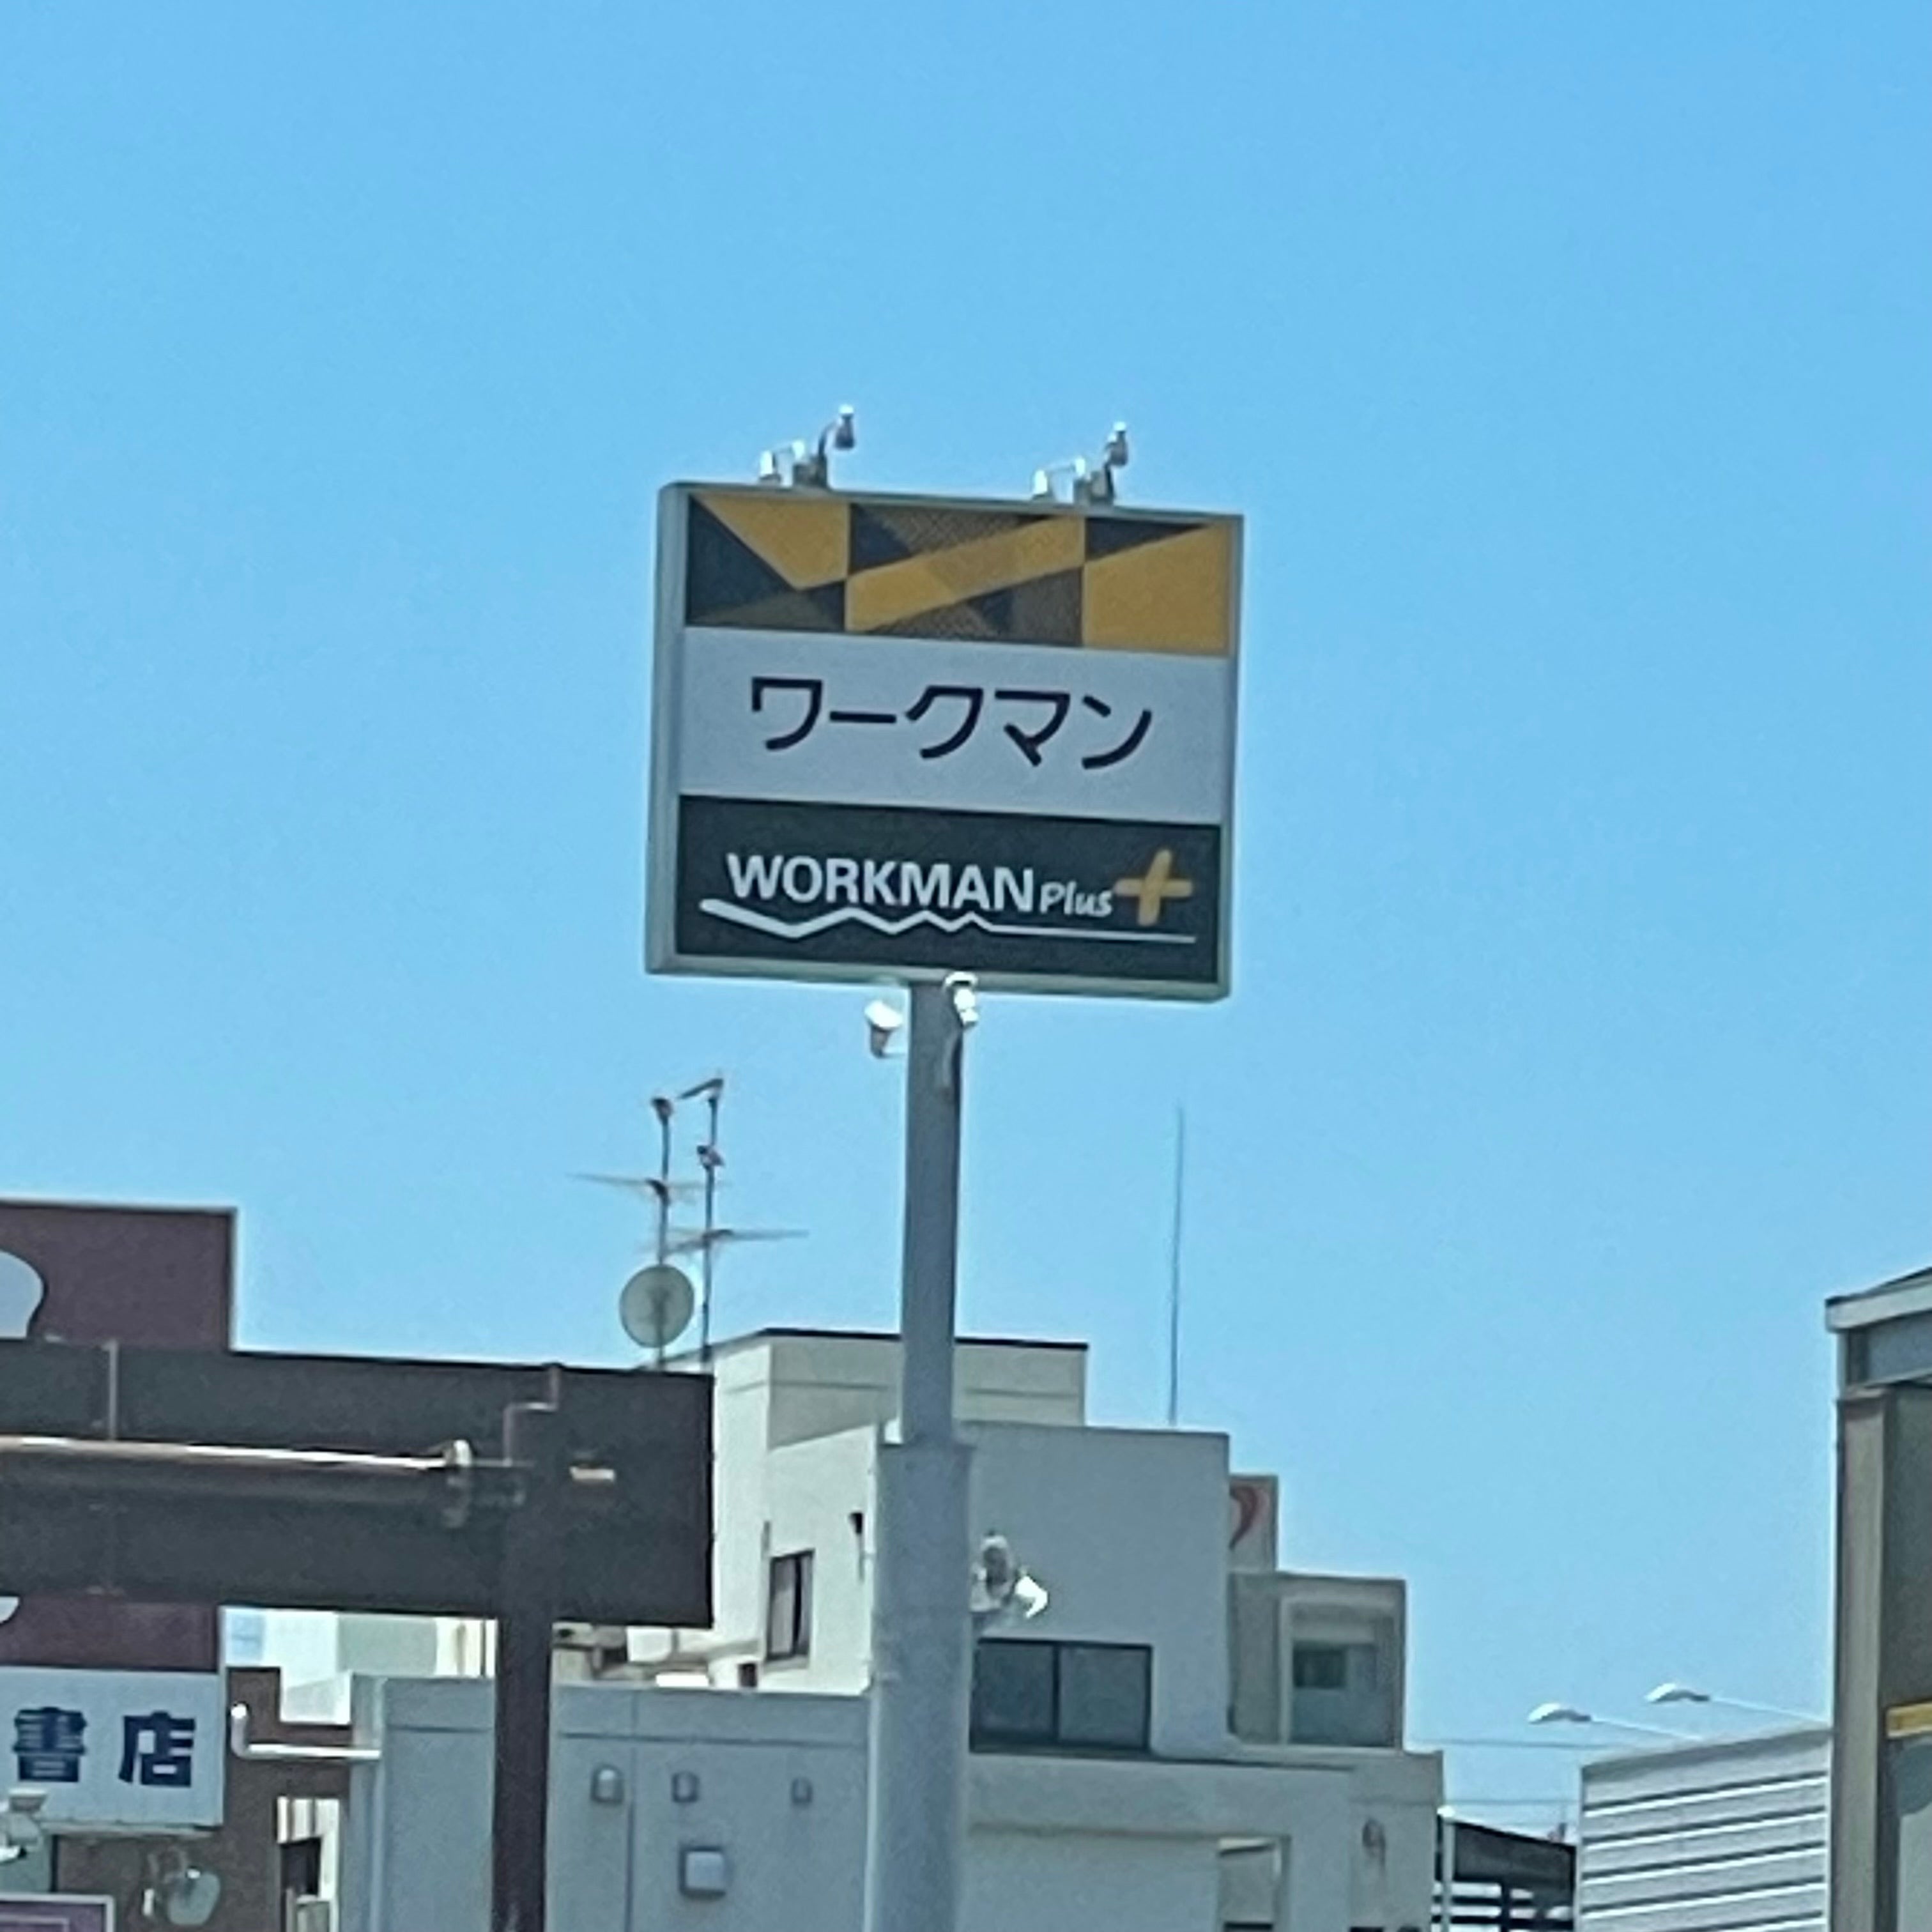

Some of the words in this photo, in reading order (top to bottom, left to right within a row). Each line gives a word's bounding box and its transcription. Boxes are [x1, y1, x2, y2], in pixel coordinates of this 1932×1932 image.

[751, 676, 1152, 769] ワークマン
[726, 853, 1034, 913] WORKMAN
[1039, 880, 1113, 917] Plus
[13, 1706, 197, 1787] 書店
